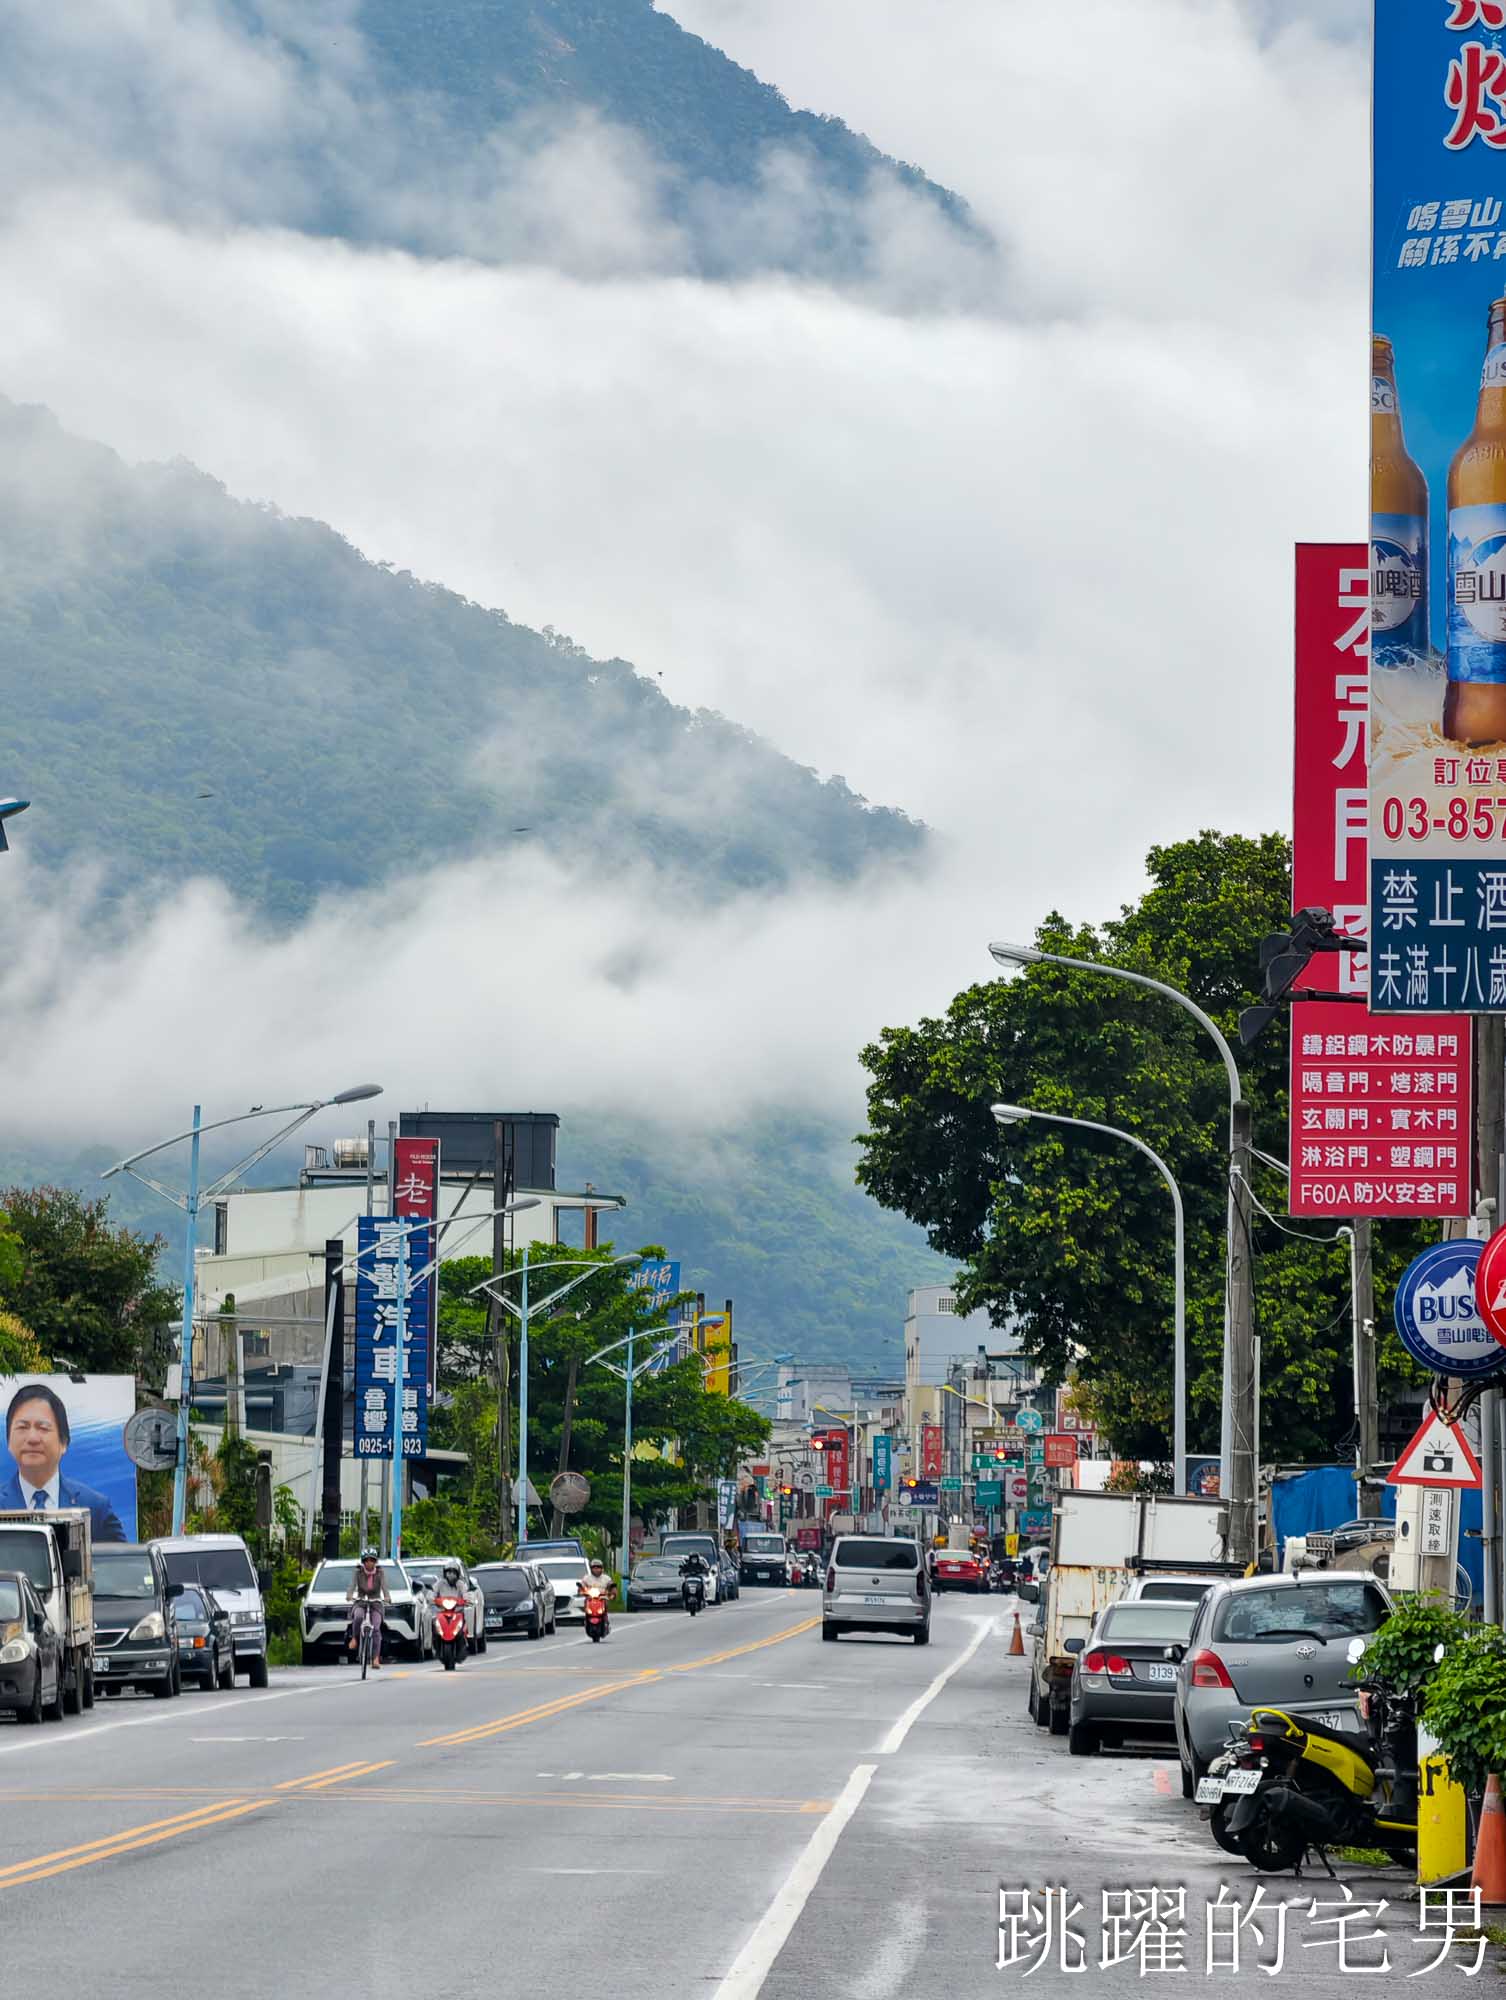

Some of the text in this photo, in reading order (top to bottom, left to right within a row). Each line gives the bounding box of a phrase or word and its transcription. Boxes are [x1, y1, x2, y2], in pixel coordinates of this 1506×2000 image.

[1382, 869, 1506, 931] 禁止酒
[1420, 1295, 1483, 1324] BUS
[1427, 1493, 1443, 1551] 測速取締
